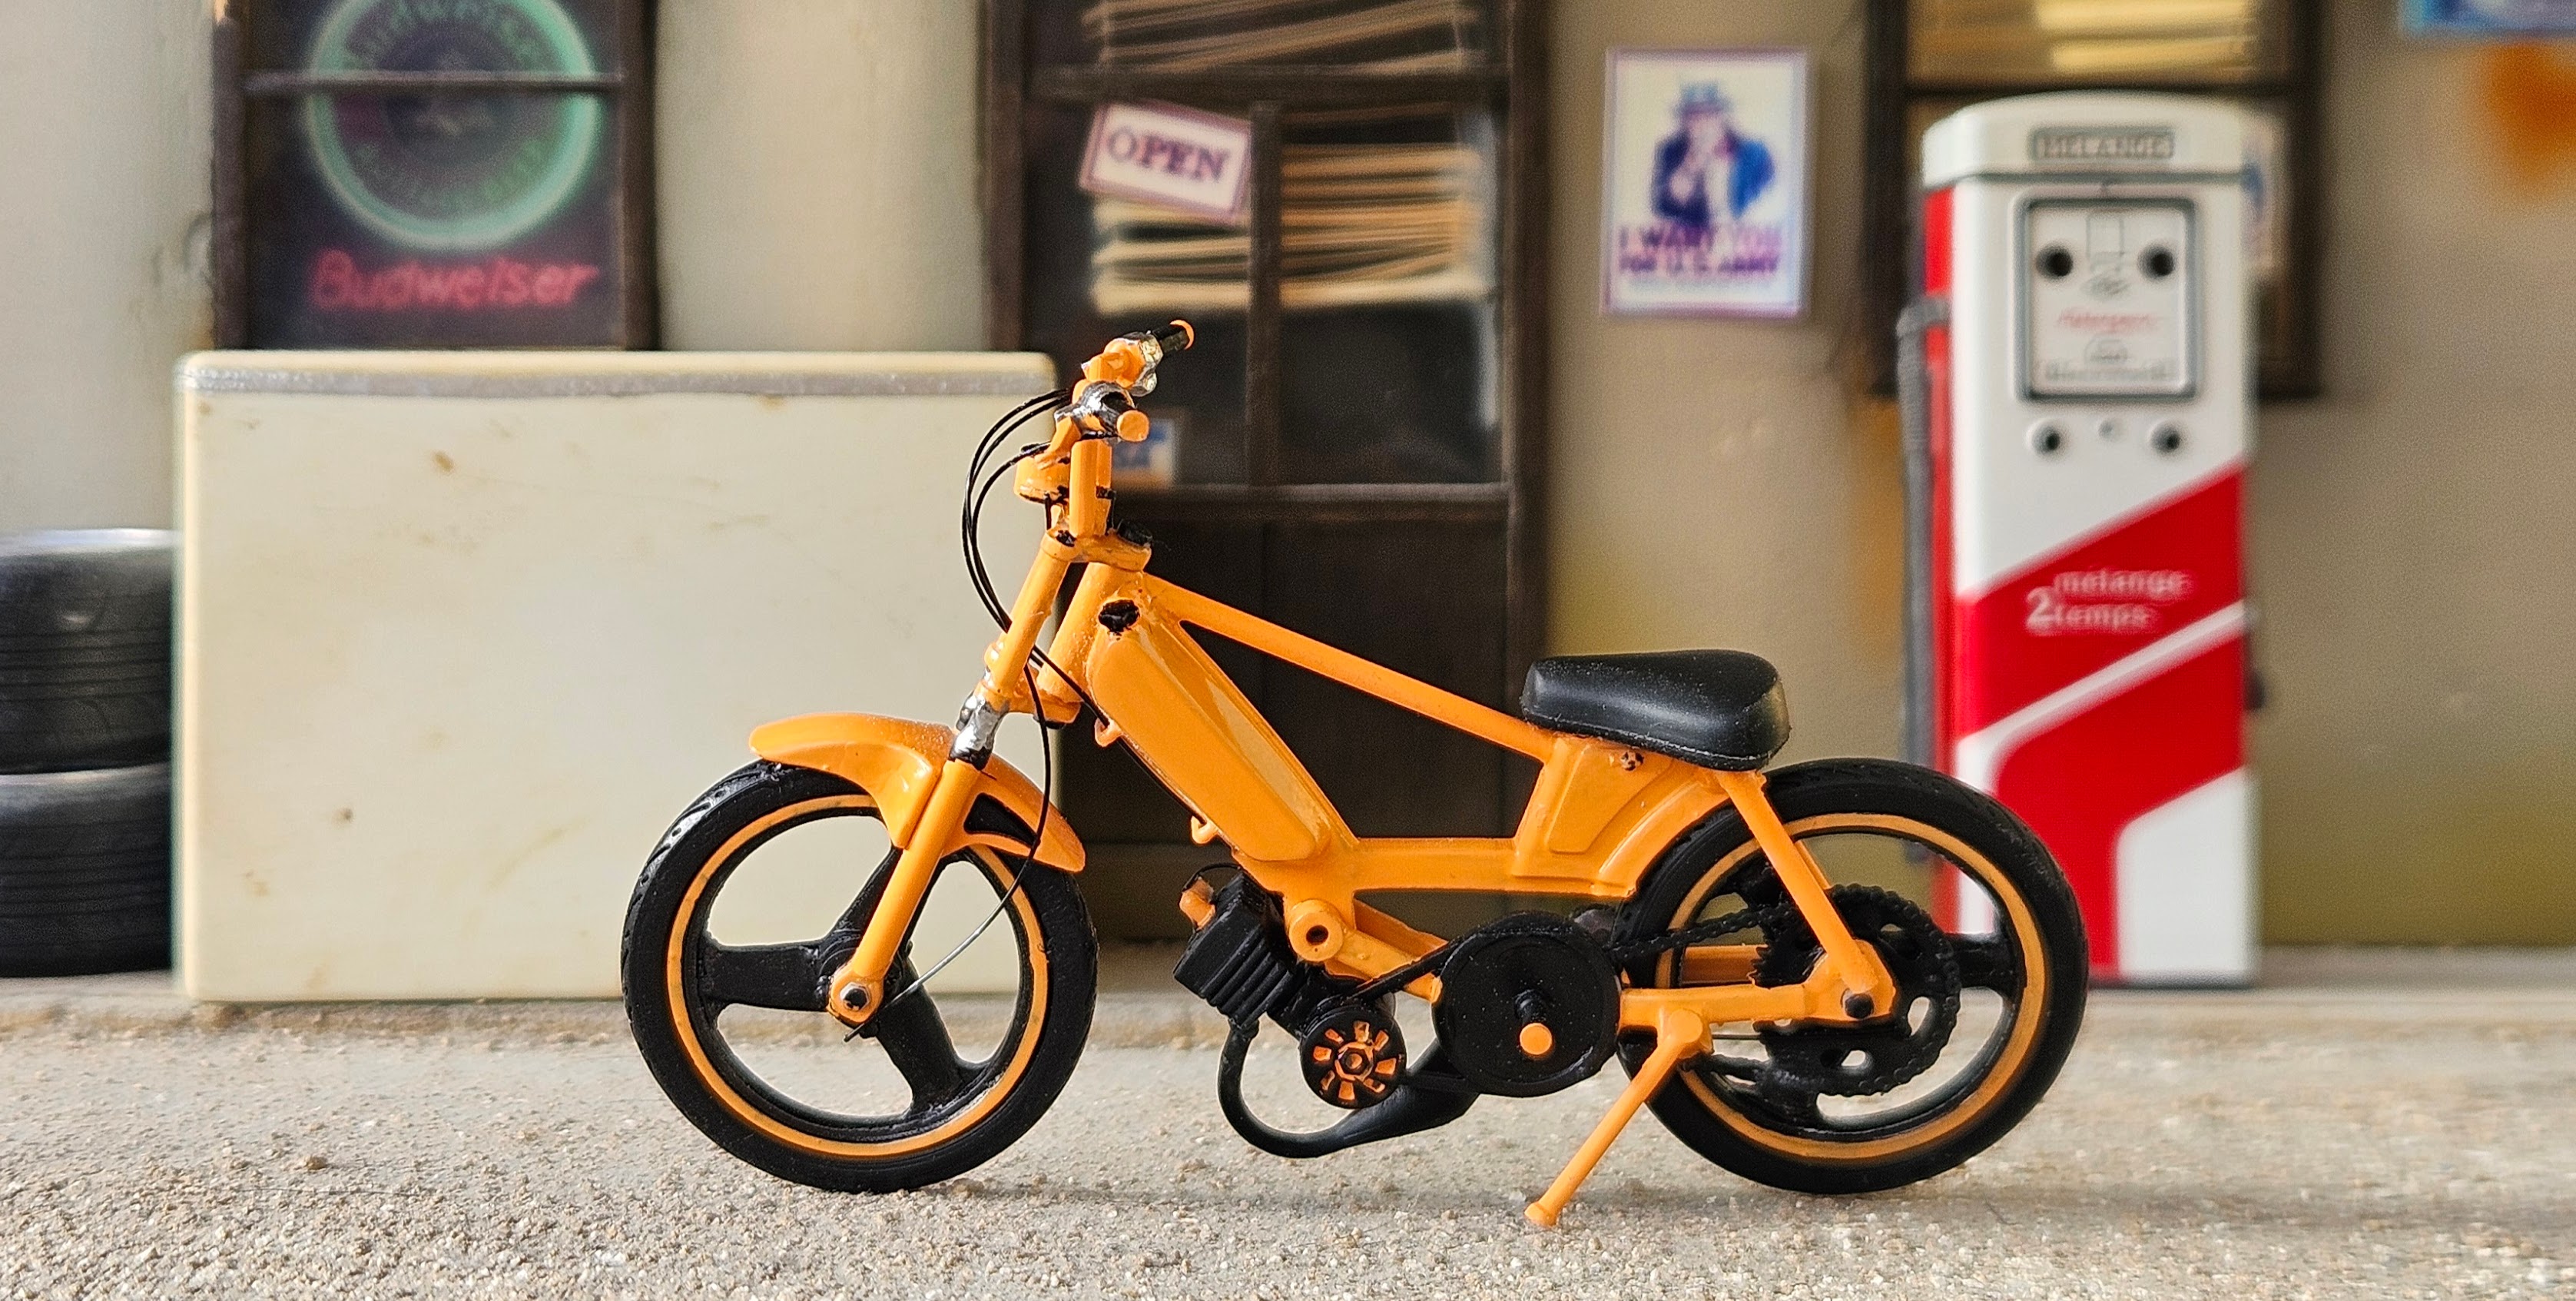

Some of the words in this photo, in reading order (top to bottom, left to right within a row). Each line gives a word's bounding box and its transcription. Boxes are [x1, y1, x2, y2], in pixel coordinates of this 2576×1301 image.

[1109, 128, 1229, 181] OPEN
[313, 250, 598, 308] Budweiser
[2026, 586, 2053, 635] 2
